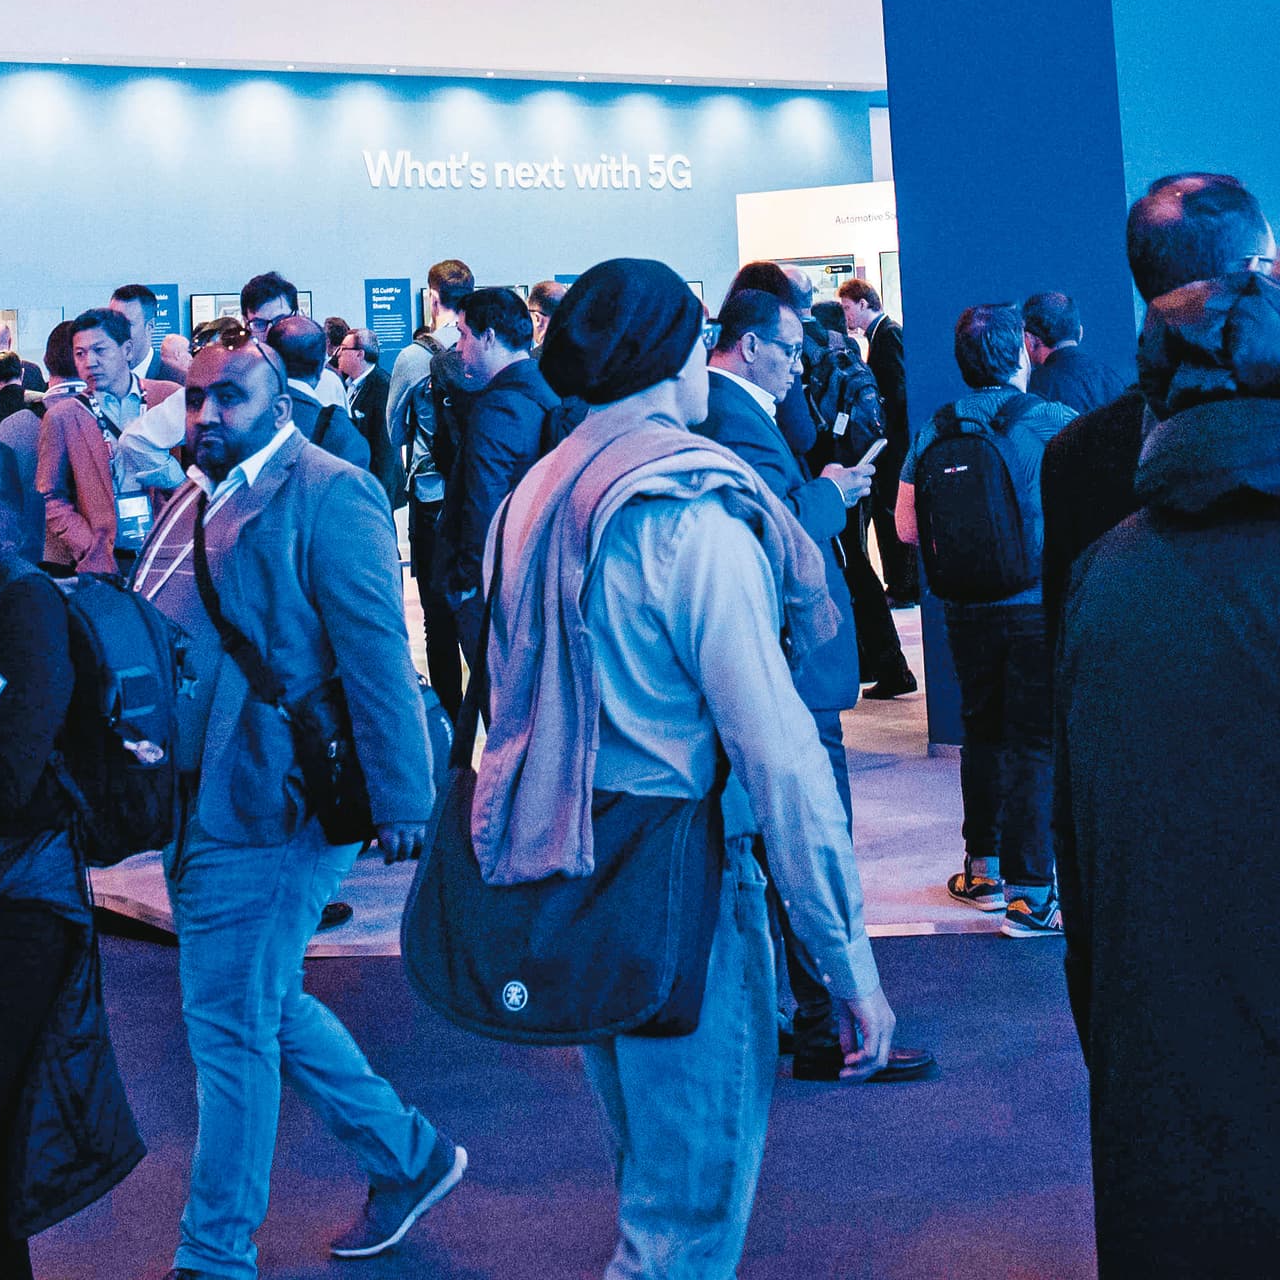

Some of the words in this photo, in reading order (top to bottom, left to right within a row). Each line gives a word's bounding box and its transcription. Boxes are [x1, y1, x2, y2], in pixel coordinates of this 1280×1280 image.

[362, 150, 487, 190] What's
[494, 155, 566, 190] next
[573, 153, 641, 190] with
[648, 154, 693, 190] 5G
[835, 212, 883, 224] Automotive
